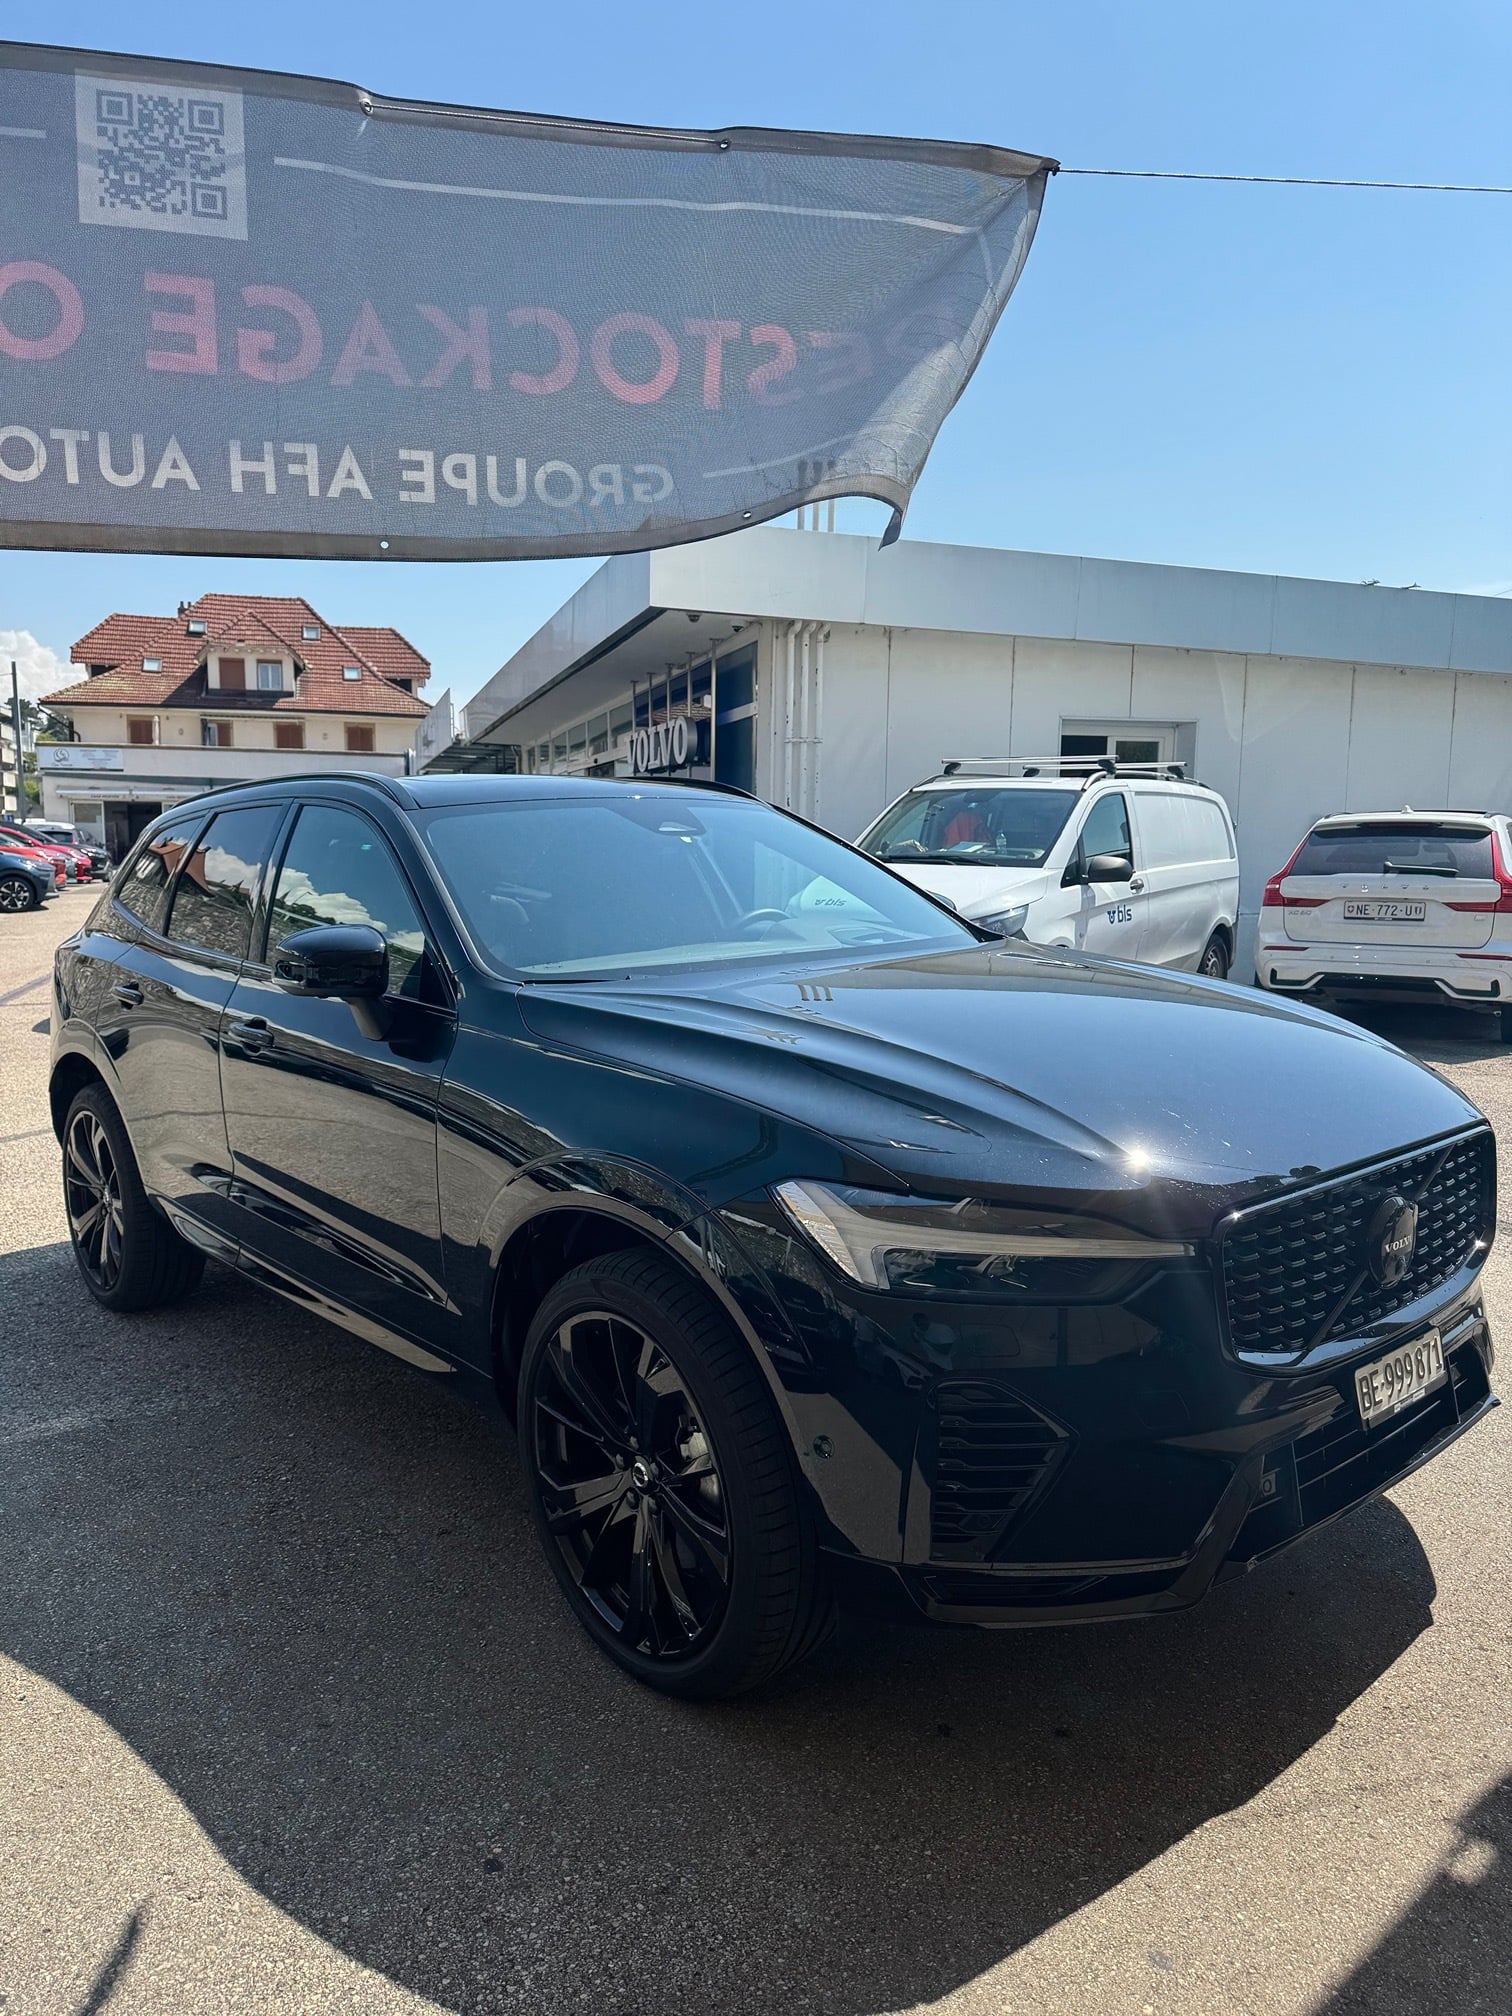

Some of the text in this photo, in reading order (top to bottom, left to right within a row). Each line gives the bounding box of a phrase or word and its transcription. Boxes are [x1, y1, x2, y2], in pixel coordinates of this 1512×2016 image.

[626, 716, 688, 772] VOLVO
[1117, 904, 1132, 923] bls
[1385, 1235, 1412, 1252] VOLV
